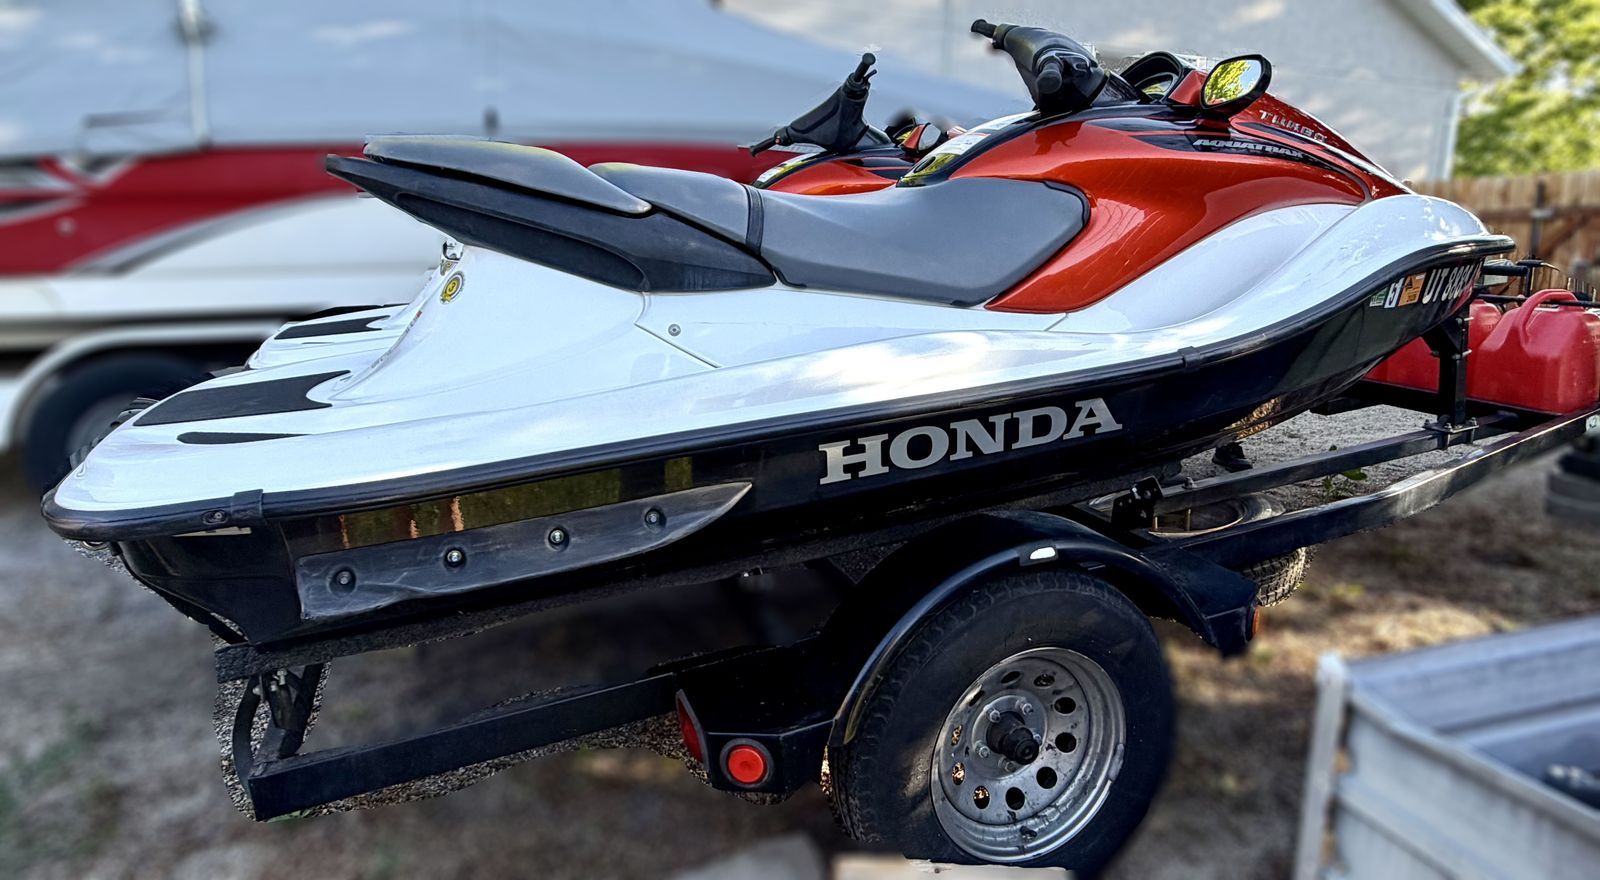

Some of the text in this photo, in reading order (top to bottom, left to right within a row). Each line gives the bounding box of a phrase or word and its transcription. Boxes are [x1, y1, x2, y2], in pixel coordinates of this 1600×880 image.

[1259, 109, 1327, 143] TURBO
[1192, 138, 1303, 158] AQUATRAX
[1422, 267, 1451, 305] UT
[818, 397, 1123, 486] HONDA
